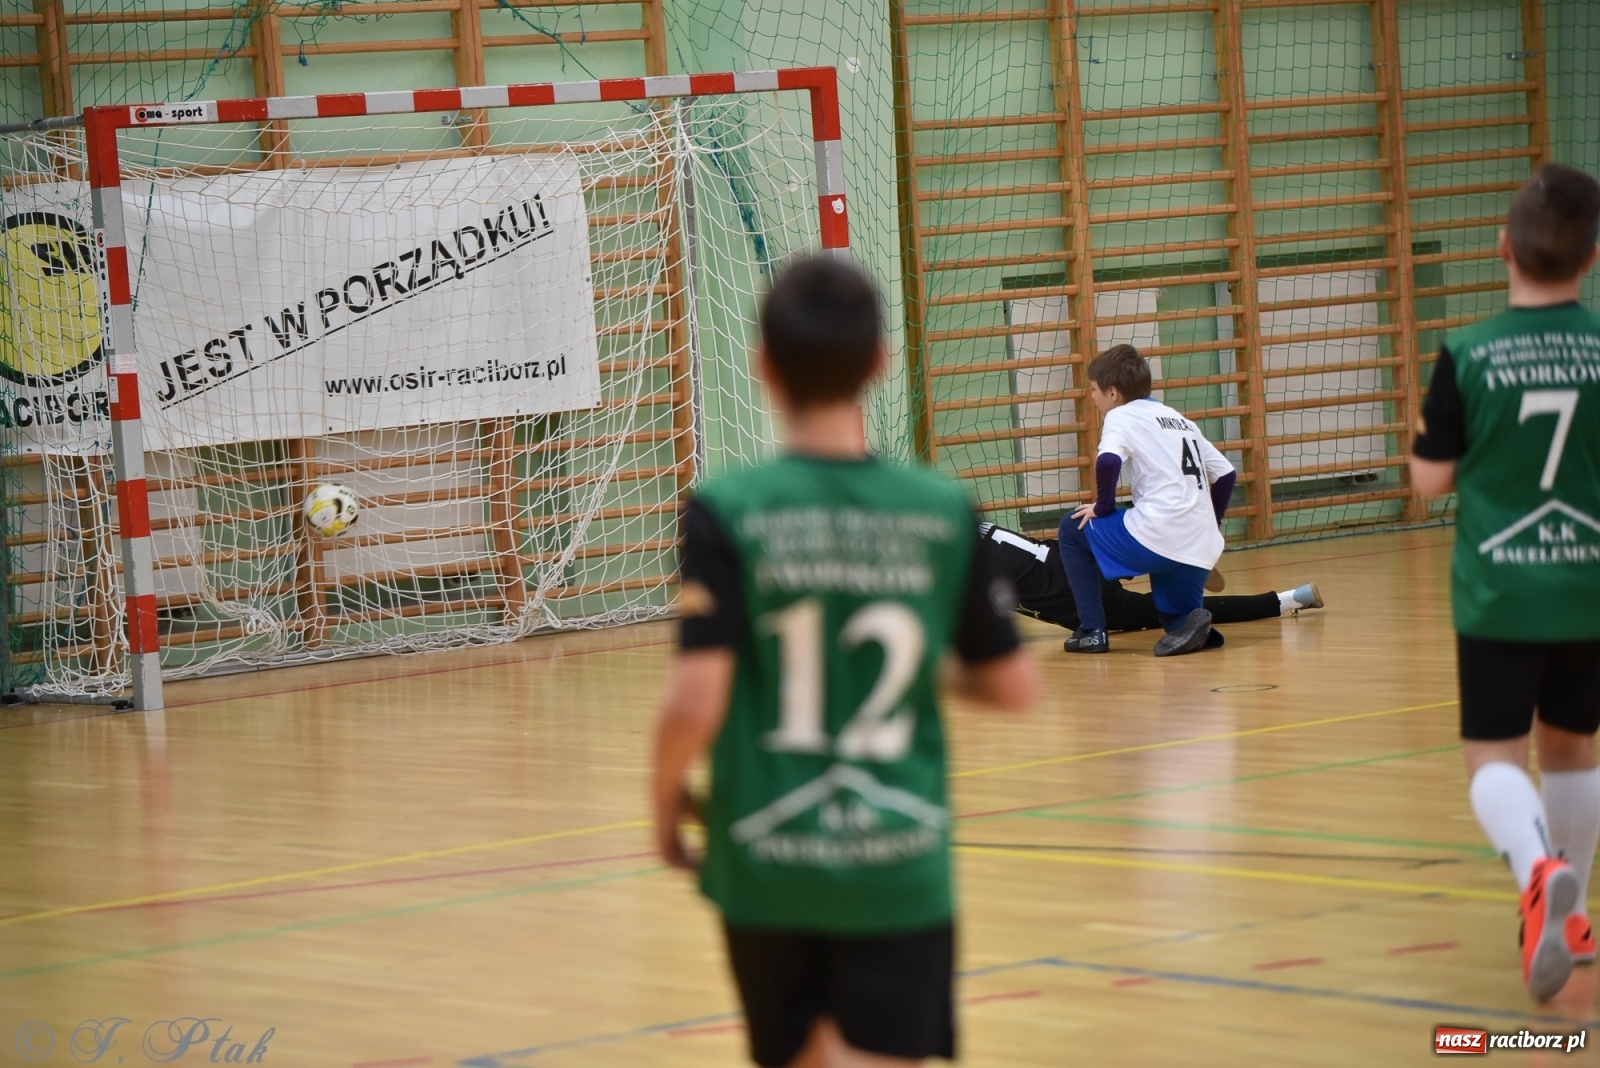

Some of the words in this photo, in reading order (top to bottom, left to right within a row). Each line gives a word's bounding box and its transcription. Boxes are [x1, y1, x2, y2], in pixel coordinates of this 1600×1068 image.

[171, 106, 203, 121] sport
[155, 323, 254, 402] JEST
[264, 301, 308, 349] W
[315, 193, 550, 329] PORZĄDKU!
[325, 353, 567, 395] www.osir-raciborz.pl
[1518, 388, 1579, 491] 7
[755, 599, 925, 763] 12
